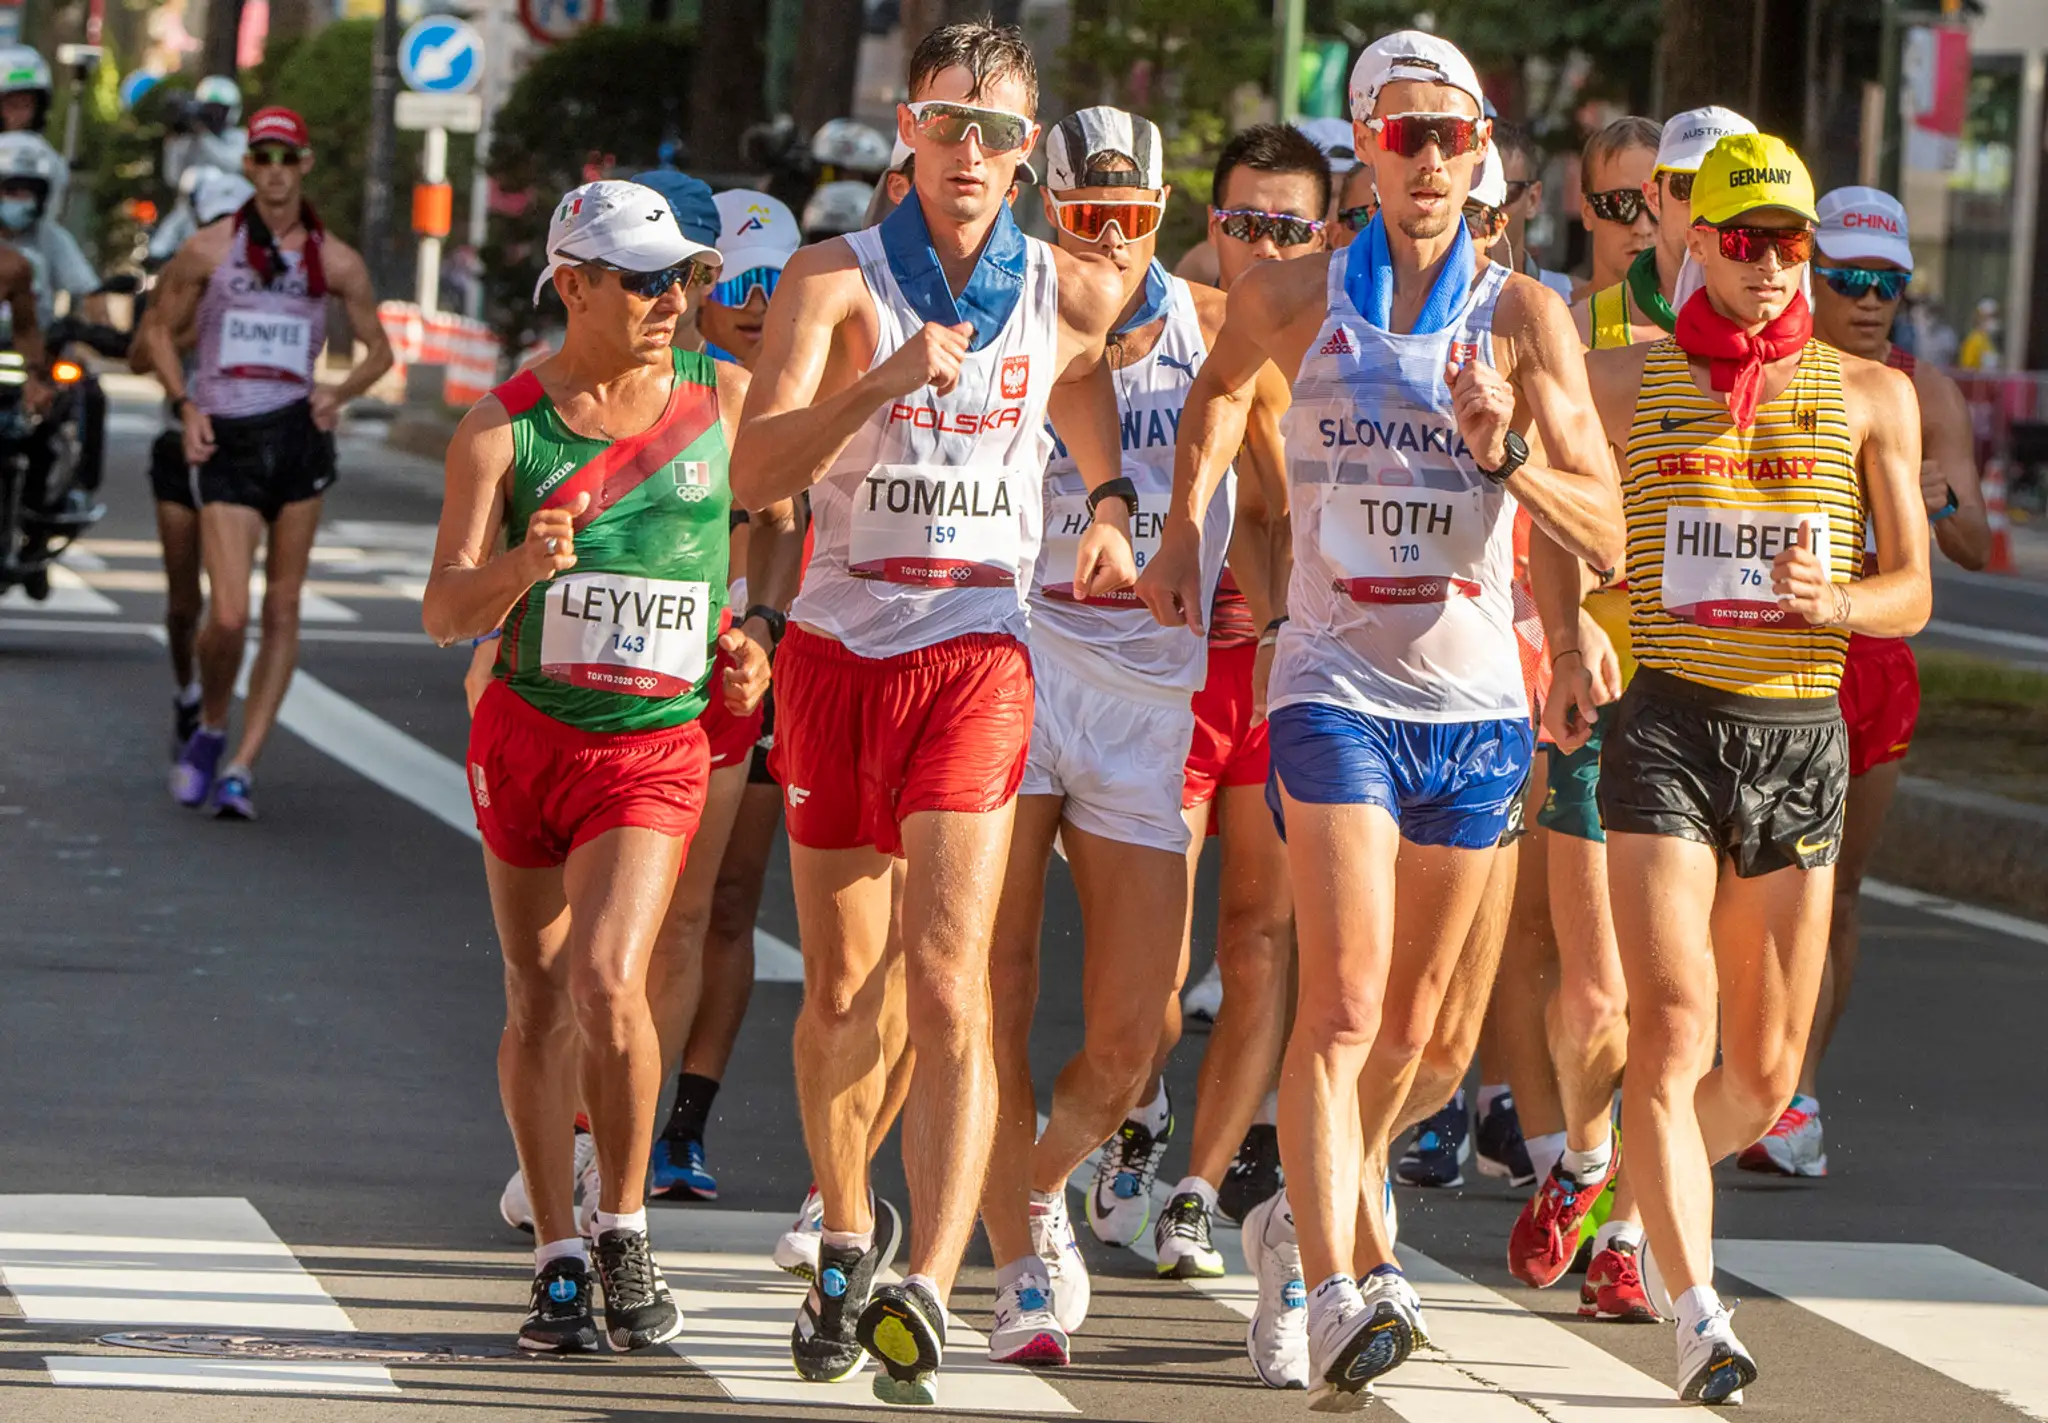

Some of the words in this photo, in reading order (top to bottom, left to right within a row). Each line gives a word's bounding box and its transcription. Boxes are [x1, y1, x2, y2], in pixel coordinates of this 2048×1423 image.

[1730, 168, 1791, 188] GERMANY
[1843, 212, 1899, 235] CHINA
[230, 319, 302, 346] DUNFEE
[1320, 345, 1353, 355] adidas
[890, 403, 1021, 435] POLSKA
[1044, 407, 1184, 460] NWAY
[1319, 418, 1474, 459] SLOVAKIA
[1656, 453, 1818, 481] GERMANY
[866, 477, 1012, 517] TOMALA
[1360, 499, 1453, 537] TOTH
[925, 525, 956, 543] 159
[1390, 544, 1419, 563] 170
[901, 566, 927, 577] TOKYO
[928, 567, 947, 578] 2020
[1740, 568, 1762, 586] 76
[1117, 591, 1136, 600] 2020
[1369, 585, 1397, 596] TOKYO
[1397, 587, 1416, 597] 2020
[561, 583, 696, 631] LEYVER
[1712, 608, 1738, 619] TOKYO
[1738, 609, 1758, 620] 2020
[613, 633, 645, 653] 143
[587, 671, 613, 683] TOKYO
[613, 675, 633, 686] 2020
